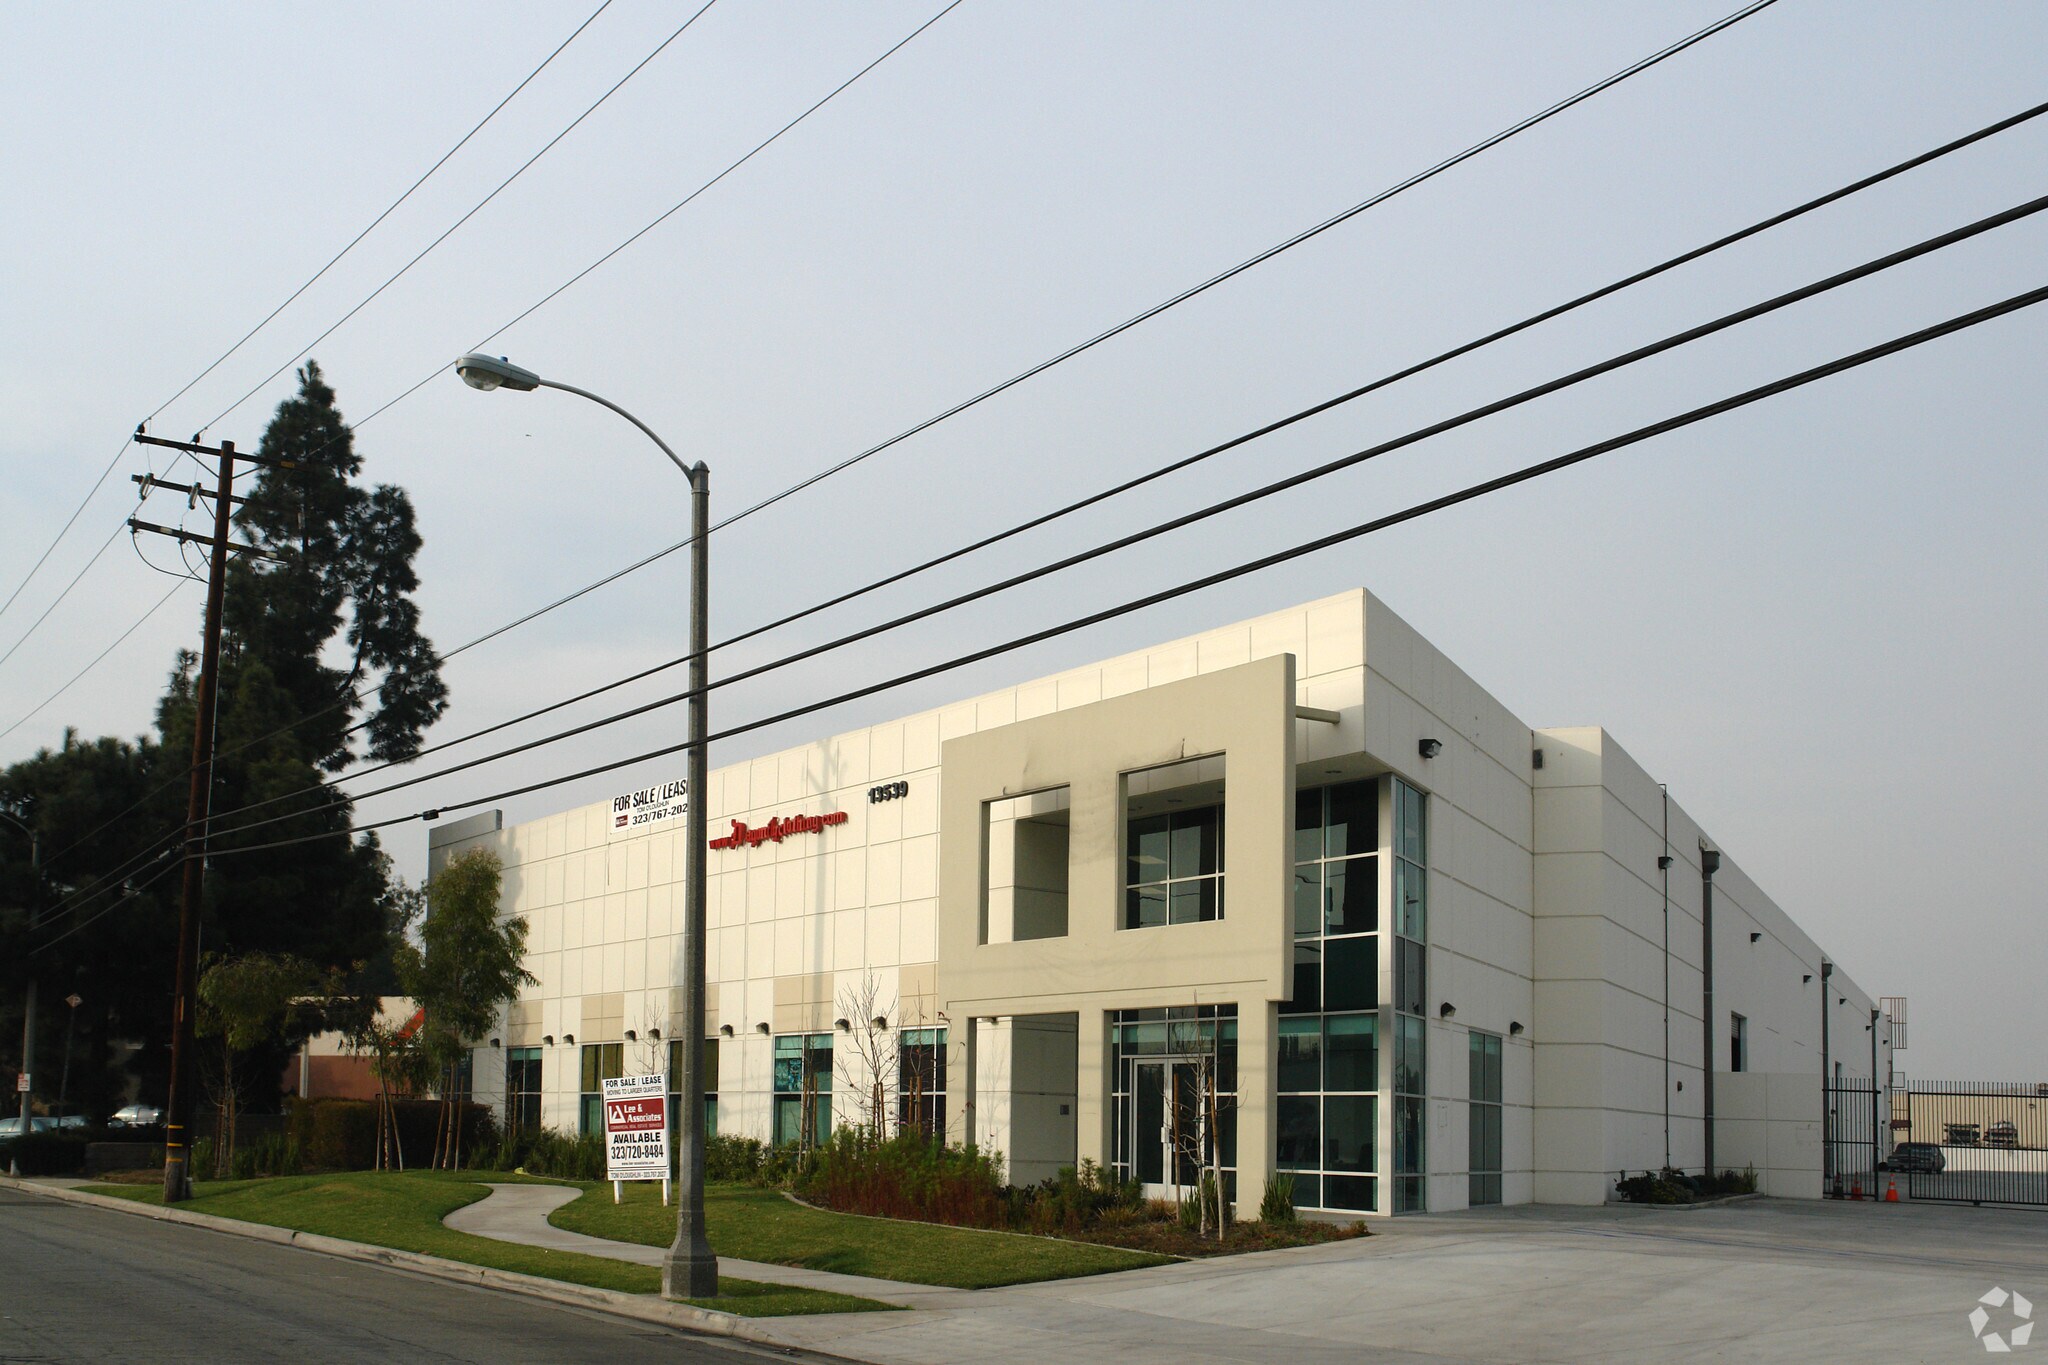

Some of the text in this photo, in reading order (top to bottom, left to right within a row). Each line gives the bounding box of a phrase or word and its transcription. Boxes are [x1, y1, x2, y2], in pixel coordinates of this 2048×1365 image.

[868, 780, 908, 804] 13539
[614, 795, 631, 812] FOR
[633, 788, 656, 807] SALE
[632, 803, 688, 825] 323/767-202
[606, 1080, 618, 1088] FOR
[620, 1078, 636, 1087] SALE
[642, 1076, 662, 1085] LEASE
[623, 1103, 643, 1114] Lee &
[627, 1113, 662, 1123] Associates
[613, 1132, 661, 1143] AVAILABLE
[611, 1144, 664, 1160] 323/720-8484
